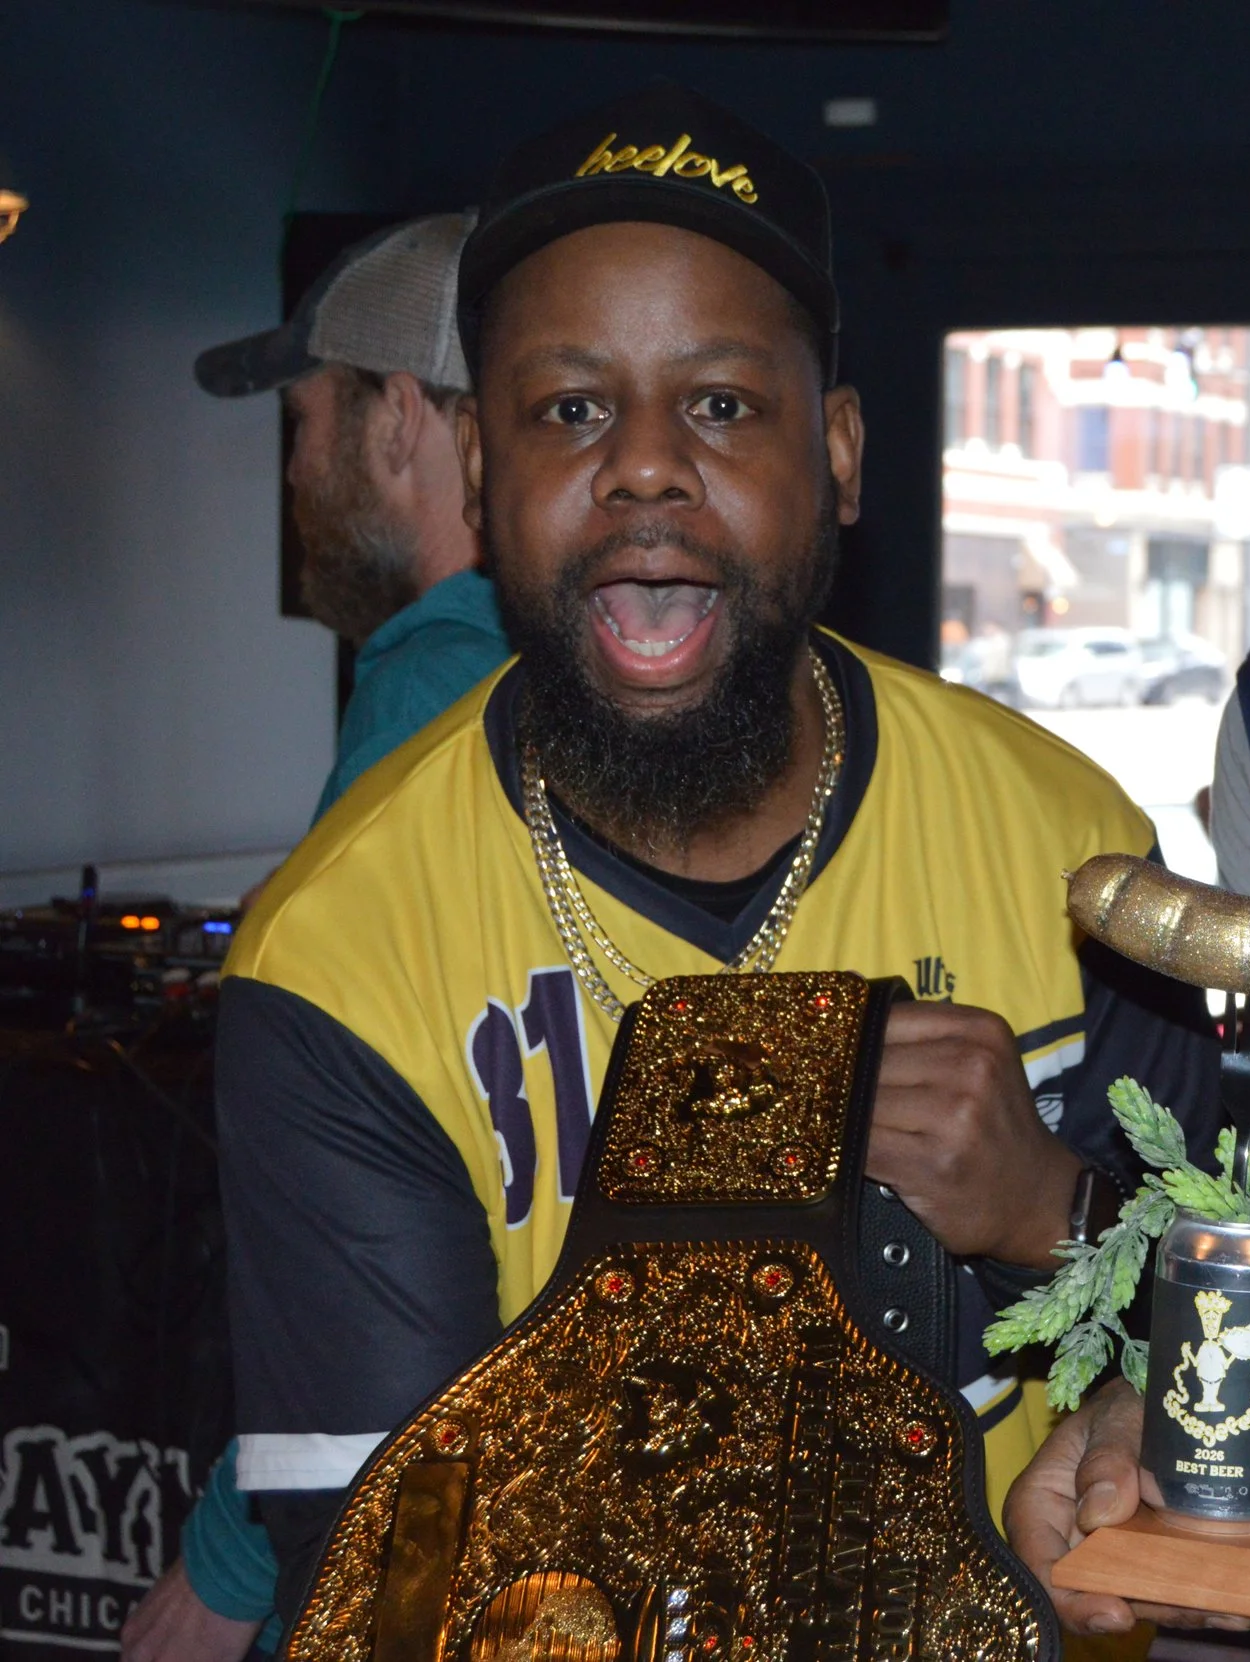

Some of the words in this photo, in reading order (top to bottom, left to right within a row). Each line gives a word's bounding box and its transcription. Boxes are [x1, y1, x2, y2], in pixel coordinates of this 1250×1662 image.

[574, 131, 758, 204] beelove
[1194, 1447, 1225, 1462] 2026
[1175, 1459, 1207, 1476] BEST
[1209, 1465, 1244, 1478] BEER
